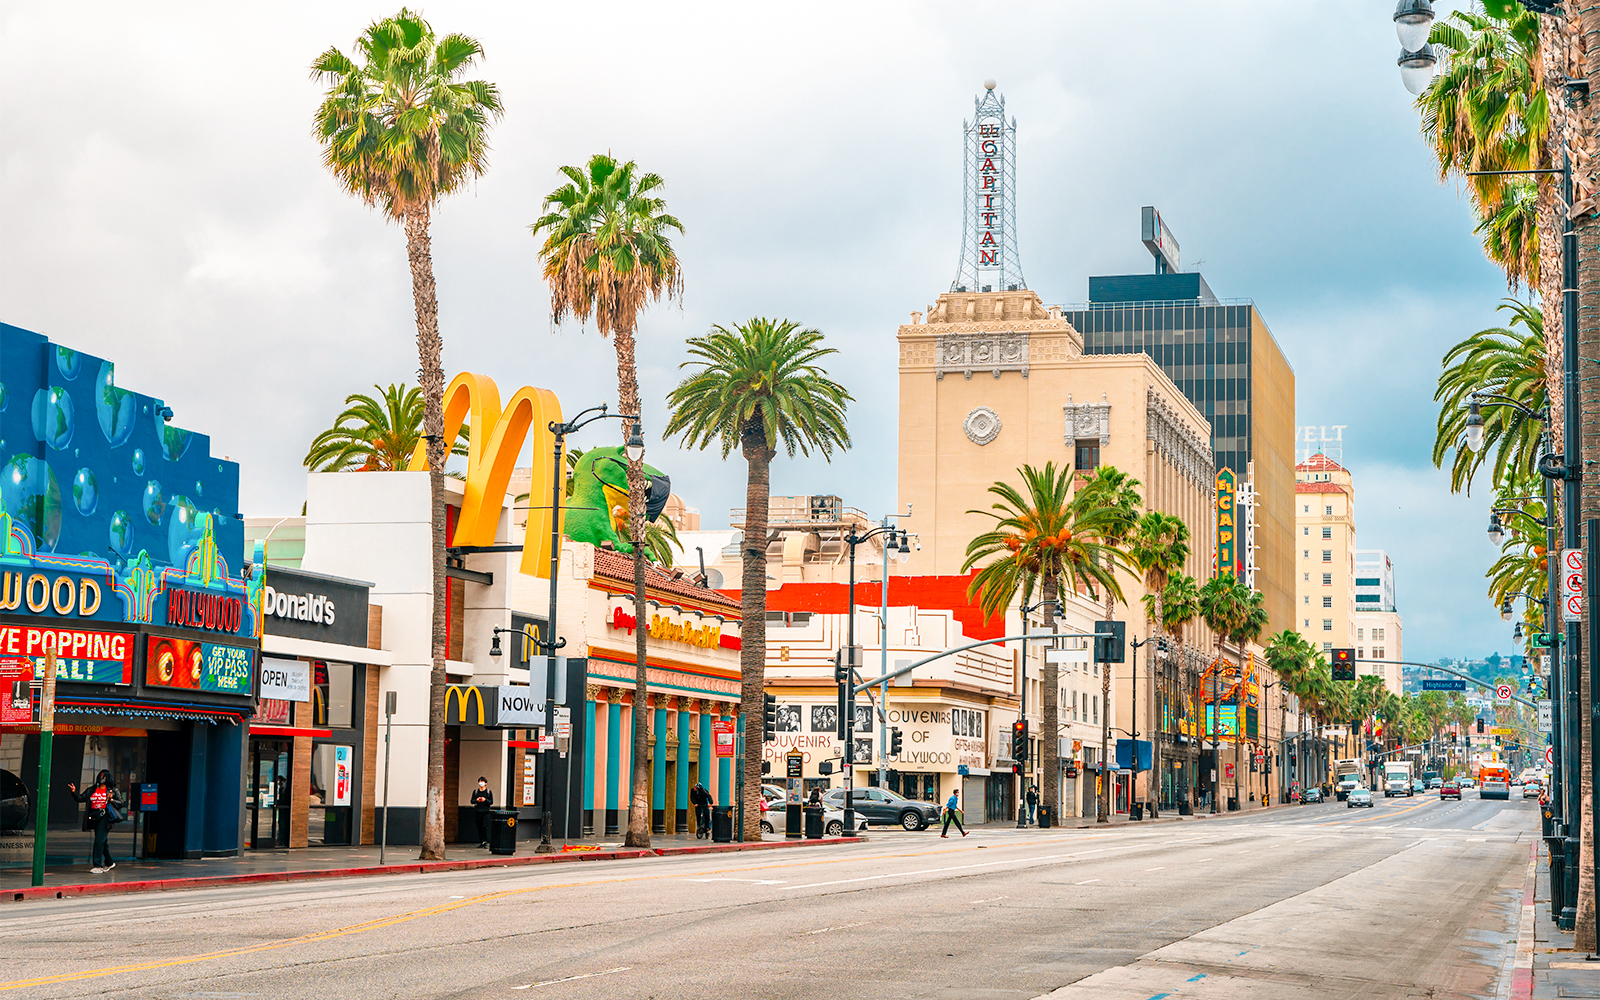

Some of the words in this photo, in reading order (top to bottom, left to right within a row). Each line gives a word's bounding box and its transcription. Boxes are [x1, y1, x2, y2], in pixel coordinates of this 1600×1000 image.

[980, 124, 998, 135] EL
[980, 140, 997, 263] CAPITAN
[1218, 479, 1233, 493] EL
[168, 588, 242, 633] HOLLYWOOD
[265, 586, 335, 625] Donald's
[26, 629, 125, 660] POPPING
[212, 646, 225, 658] GET
[227, 647, 246, 660] YOUR
[208, 656, 223, 675] VIP
[225, 657, 248, 677] PASS
[262, 669, 288, 687] OPEN
[889, 710, 951, 724] OUVENIRS
[14, 724, 41, 732] GUINNE
[911, 730, 929, 743] OF
